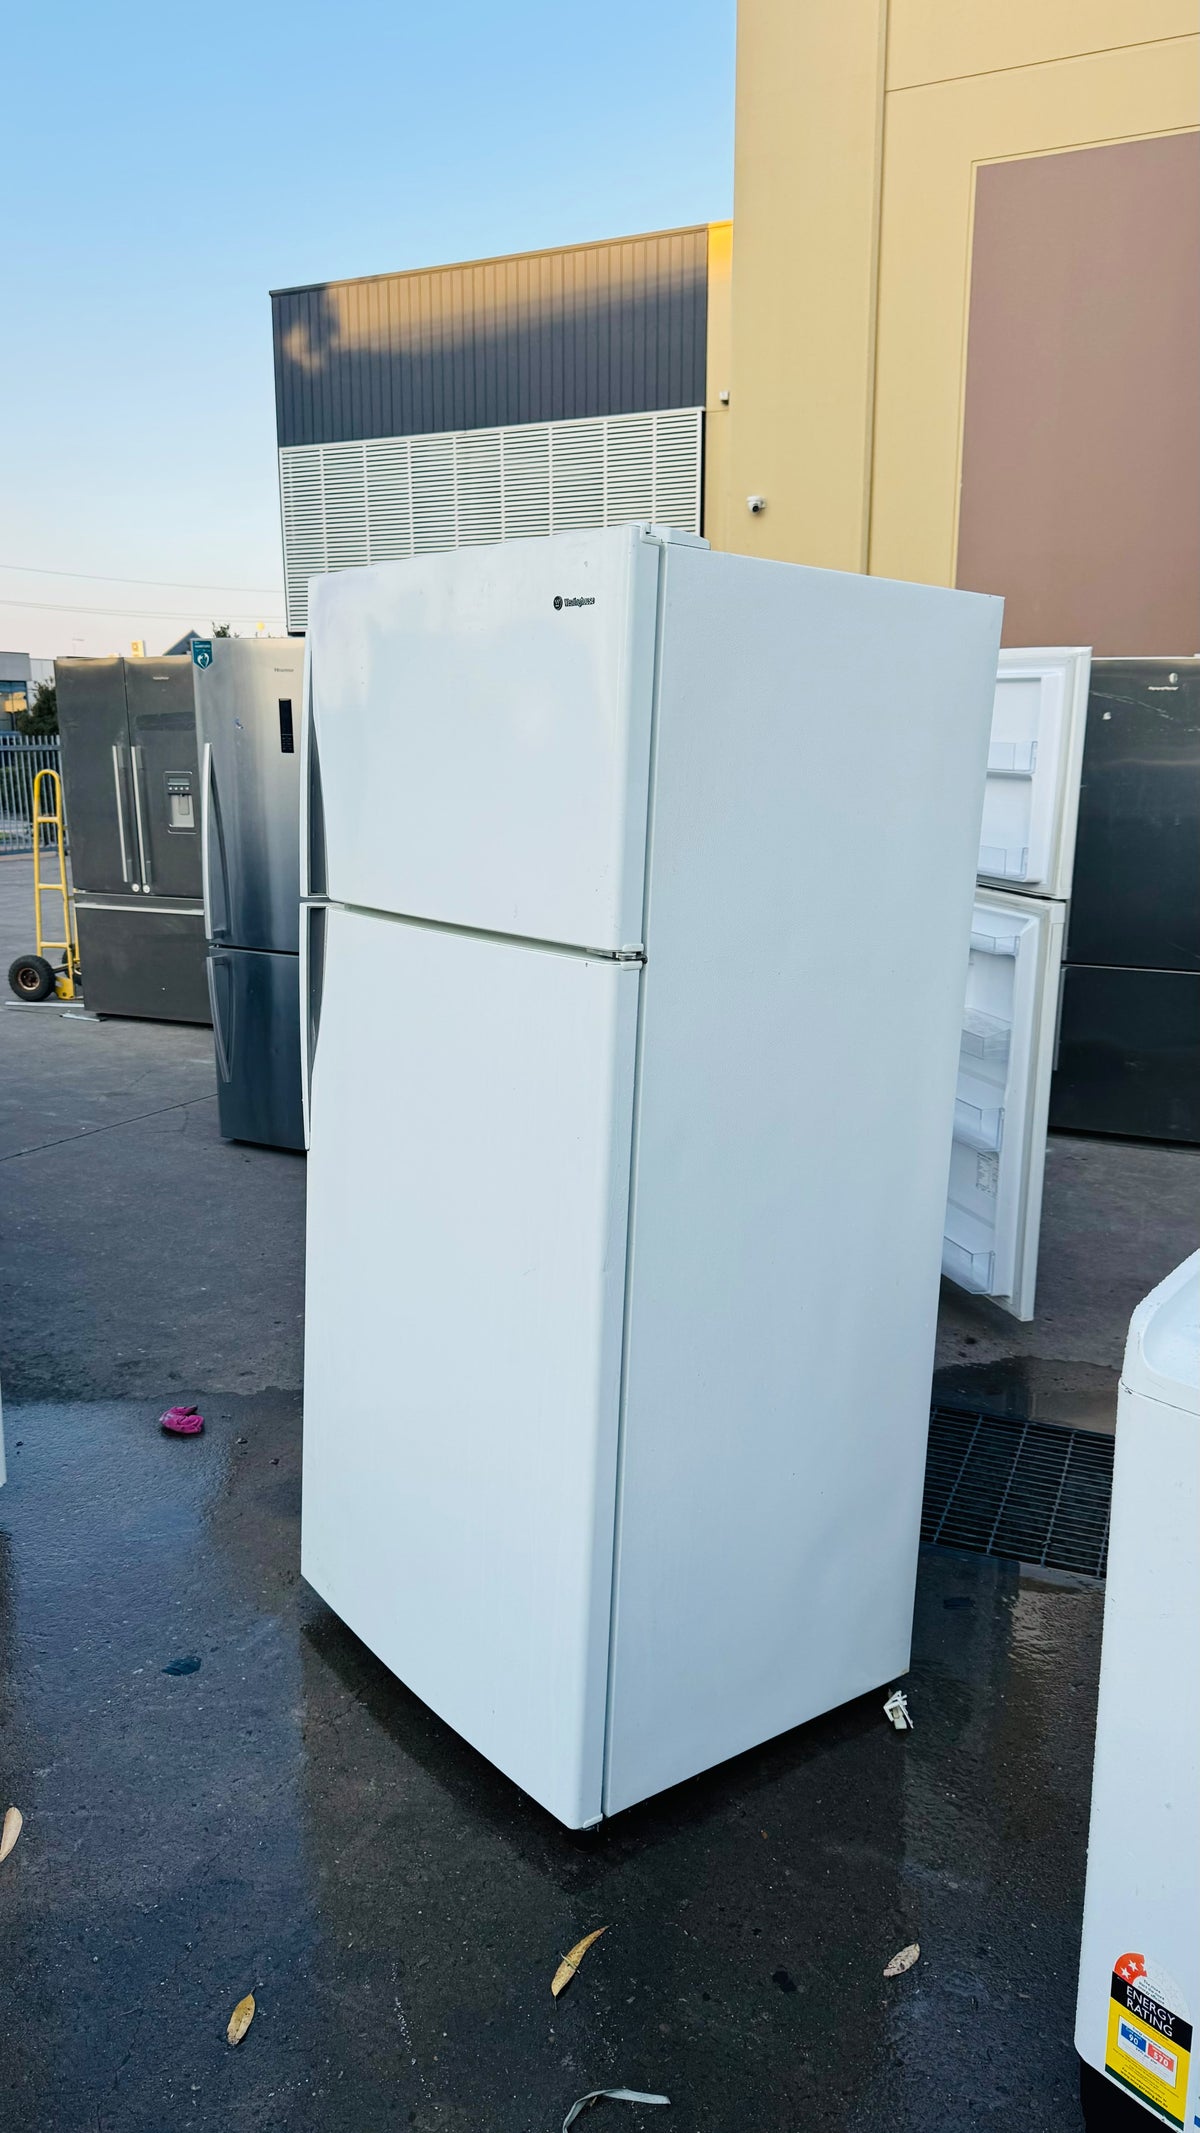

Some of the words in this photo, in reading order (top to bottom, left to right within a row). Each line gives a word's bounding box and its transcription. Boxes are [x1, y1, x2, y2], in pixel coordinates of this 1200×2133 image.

[1126, 1985, 1176, 2025] ENERGY
[1126, 1997, 1173, 2038] RATING
[1128, 2033, 1139, 2046] 90
[1153, 2051, 1169, 2067] 570
